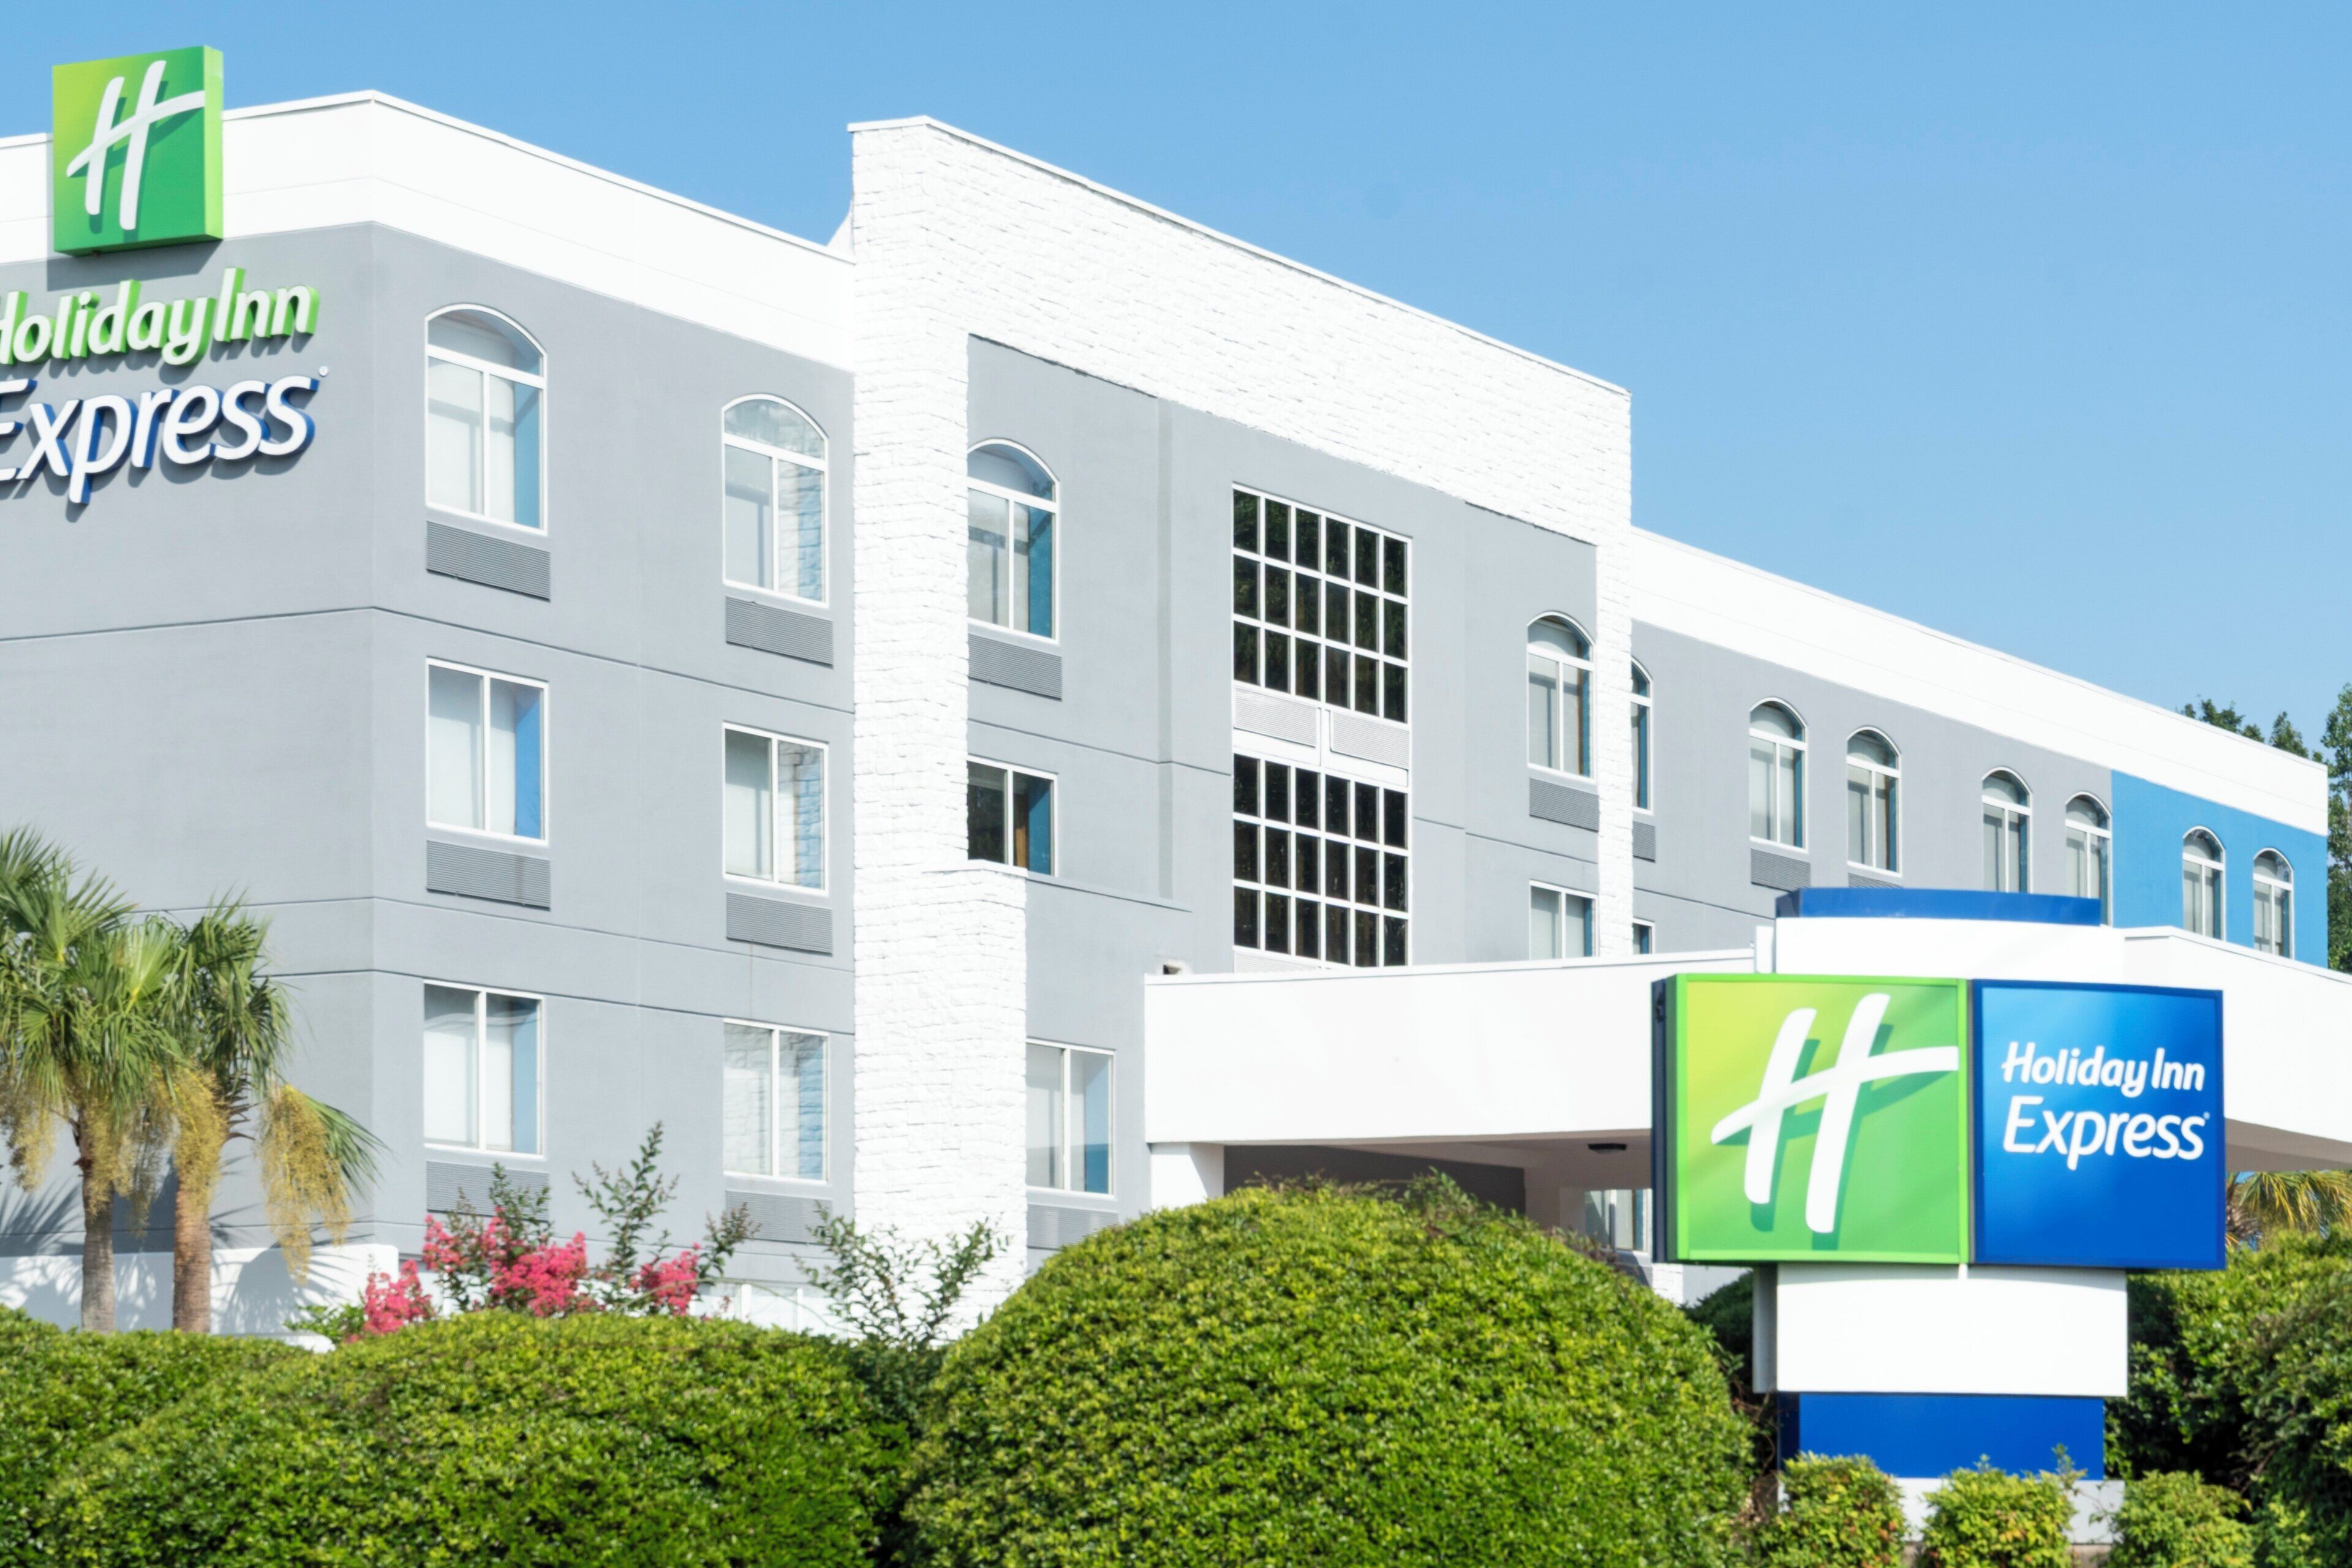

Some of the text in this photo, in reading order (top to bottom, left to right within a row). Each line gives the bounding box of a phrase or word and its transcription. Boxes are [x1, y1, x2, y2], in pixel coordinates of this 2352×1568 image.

[67, 60, 205, 230] H
[214, 267, 317, 341] Inn
[2001, 1041, 2205, 1098] Holiday Inn
[1711, 993, 1959, 1233] H
[2003, 1095, 2206, 1170] Express
